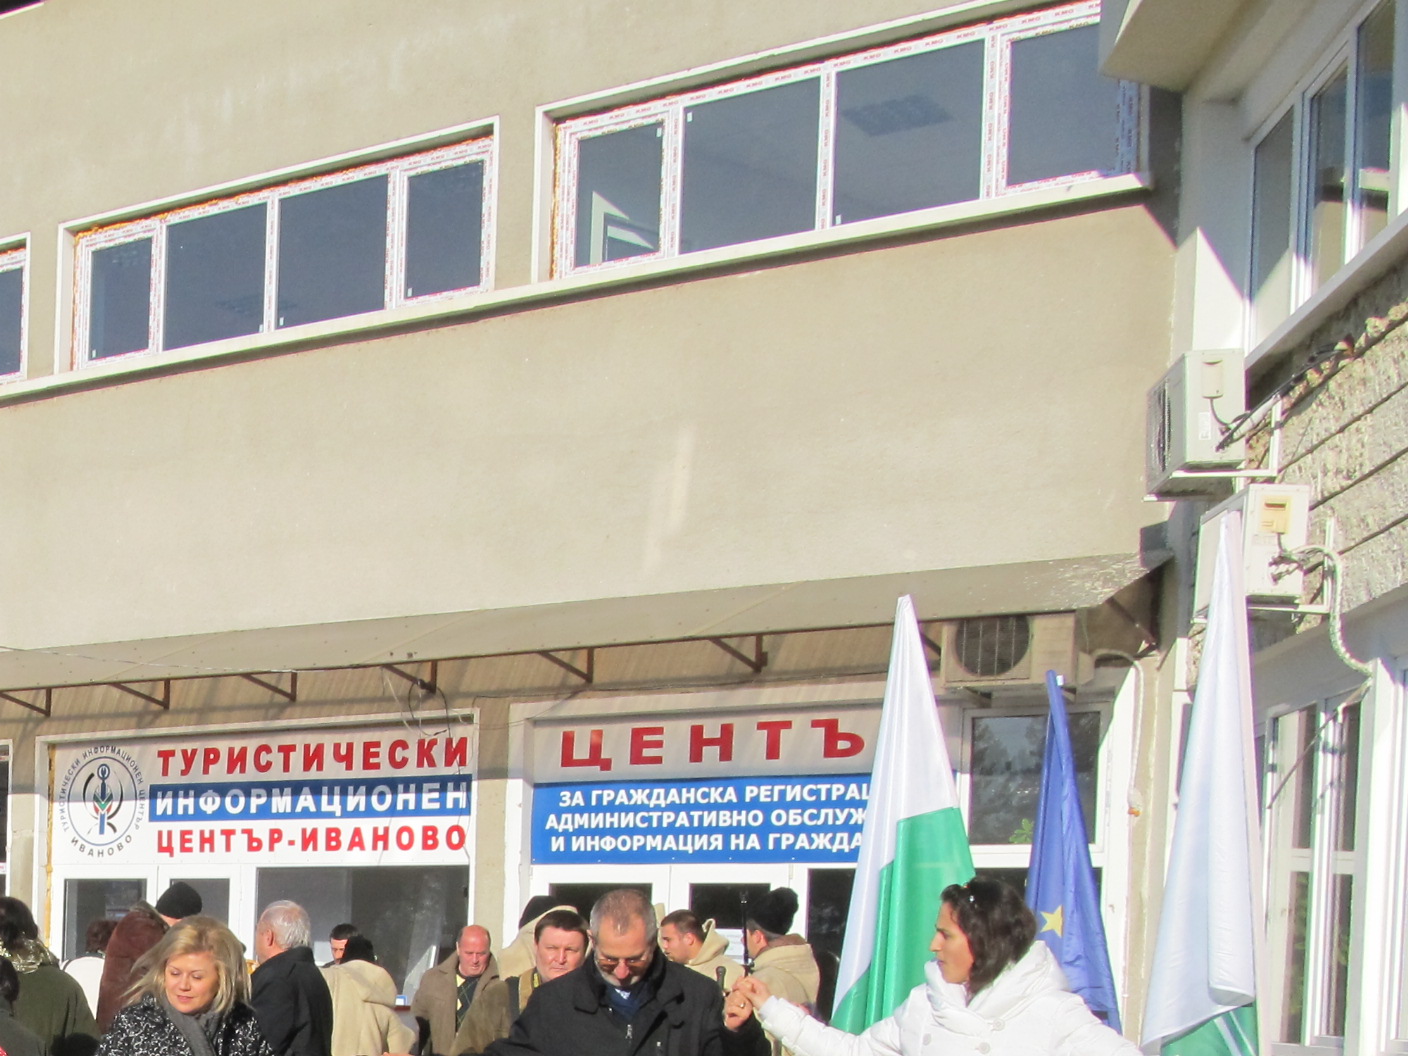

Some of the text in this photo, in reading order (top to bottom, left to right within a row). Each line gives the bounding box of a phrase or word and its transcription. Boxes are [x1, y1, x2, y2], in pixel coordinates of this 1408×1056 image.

[157, 736, 468, 777] ТУРИСТИЧЕСКИ
[560, 718, 866, 772] ЦЕНТЪ
[156, 781, 468, 817] ИНФОРМАЦИОНЕН
[558, 783, 871, 808] ЗА ГРАЖДАНСКА РЕГИСТРА
[545, 807, 867, 832] АДМИНИСТРАТИВНО ОБСЛУЖ
[70, 834, 133, 858] ИВАНОВО
[157, 824, 466, 858] ЦЕНТЪР-ИВАНОВО
[551, 832, 863, 854] И ИНФОРМАЦИЯ НА ГРАЖДА
